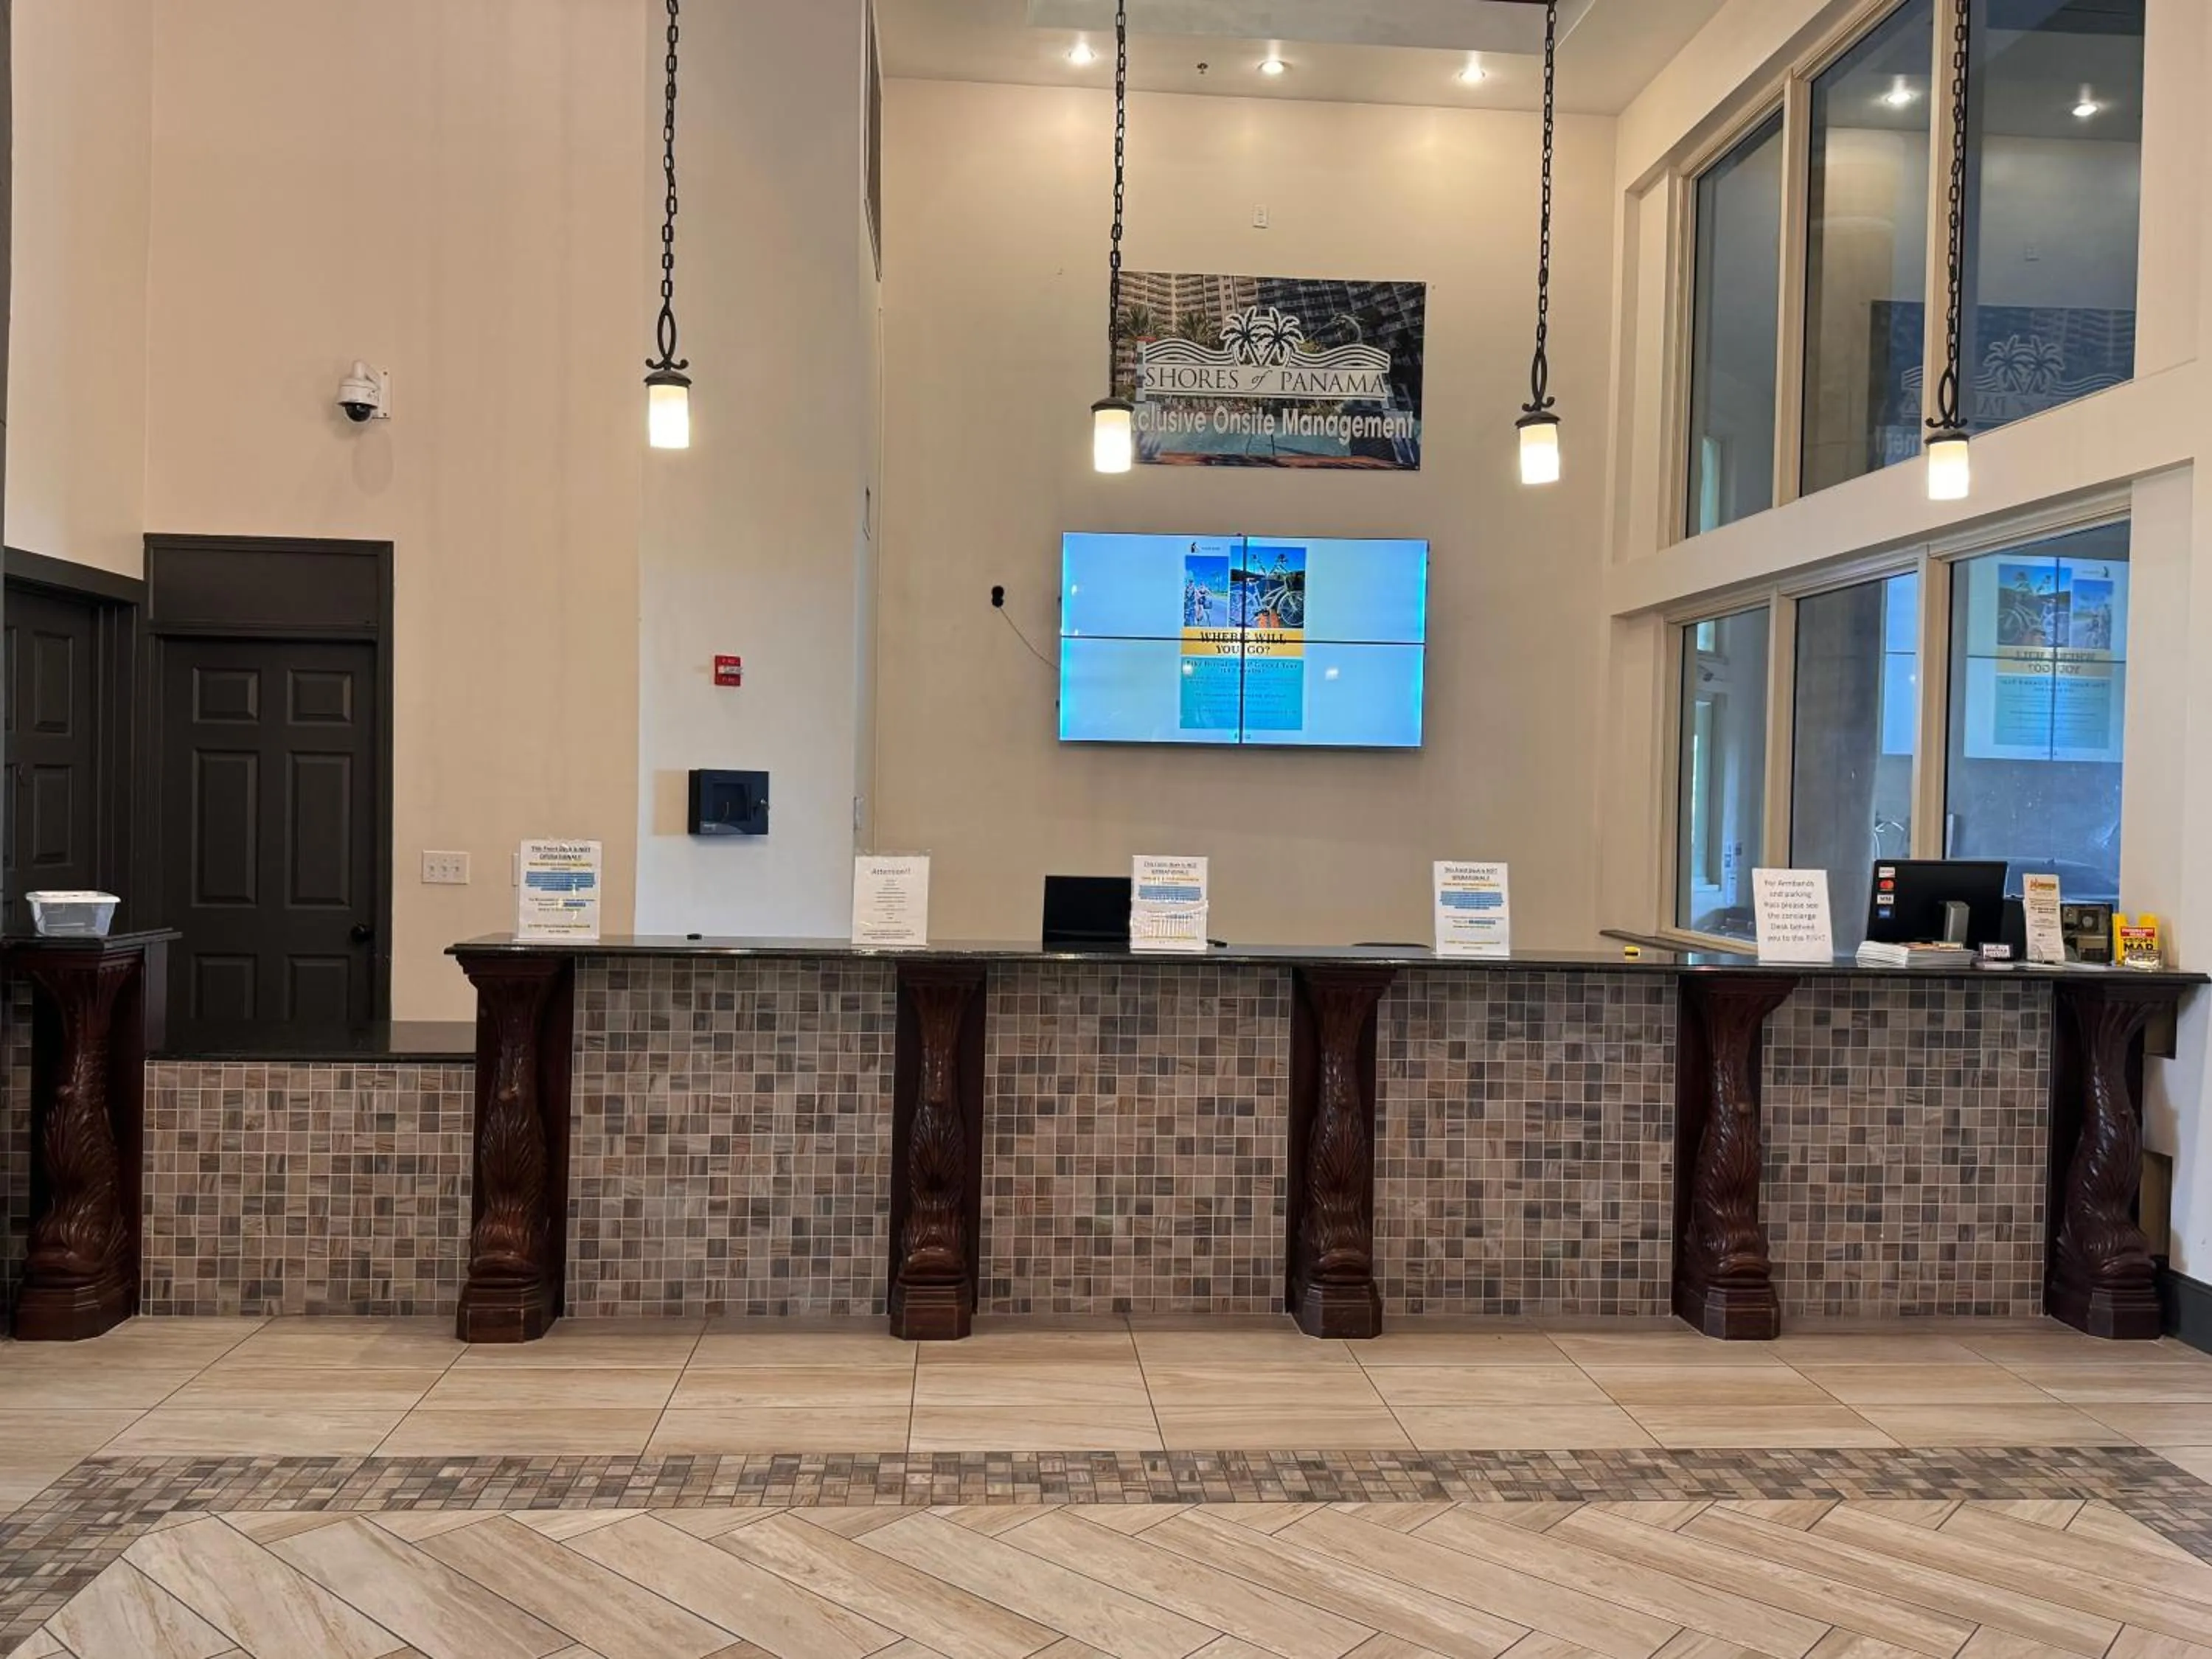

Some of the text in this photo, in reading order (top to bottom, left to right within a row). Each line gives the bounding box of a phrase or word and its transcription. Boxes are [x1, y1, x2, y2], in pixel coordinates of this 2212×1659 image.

[1144, 367, 1388, 394] SHORES of PANAMA
[1213, 405, 1276, 435] Onsite
[1282, 407, 1415, 445] Management
[1200, 631, 1287, 645] WHERE WILL
[1216, 644, 1270, 655] YOU GO?
